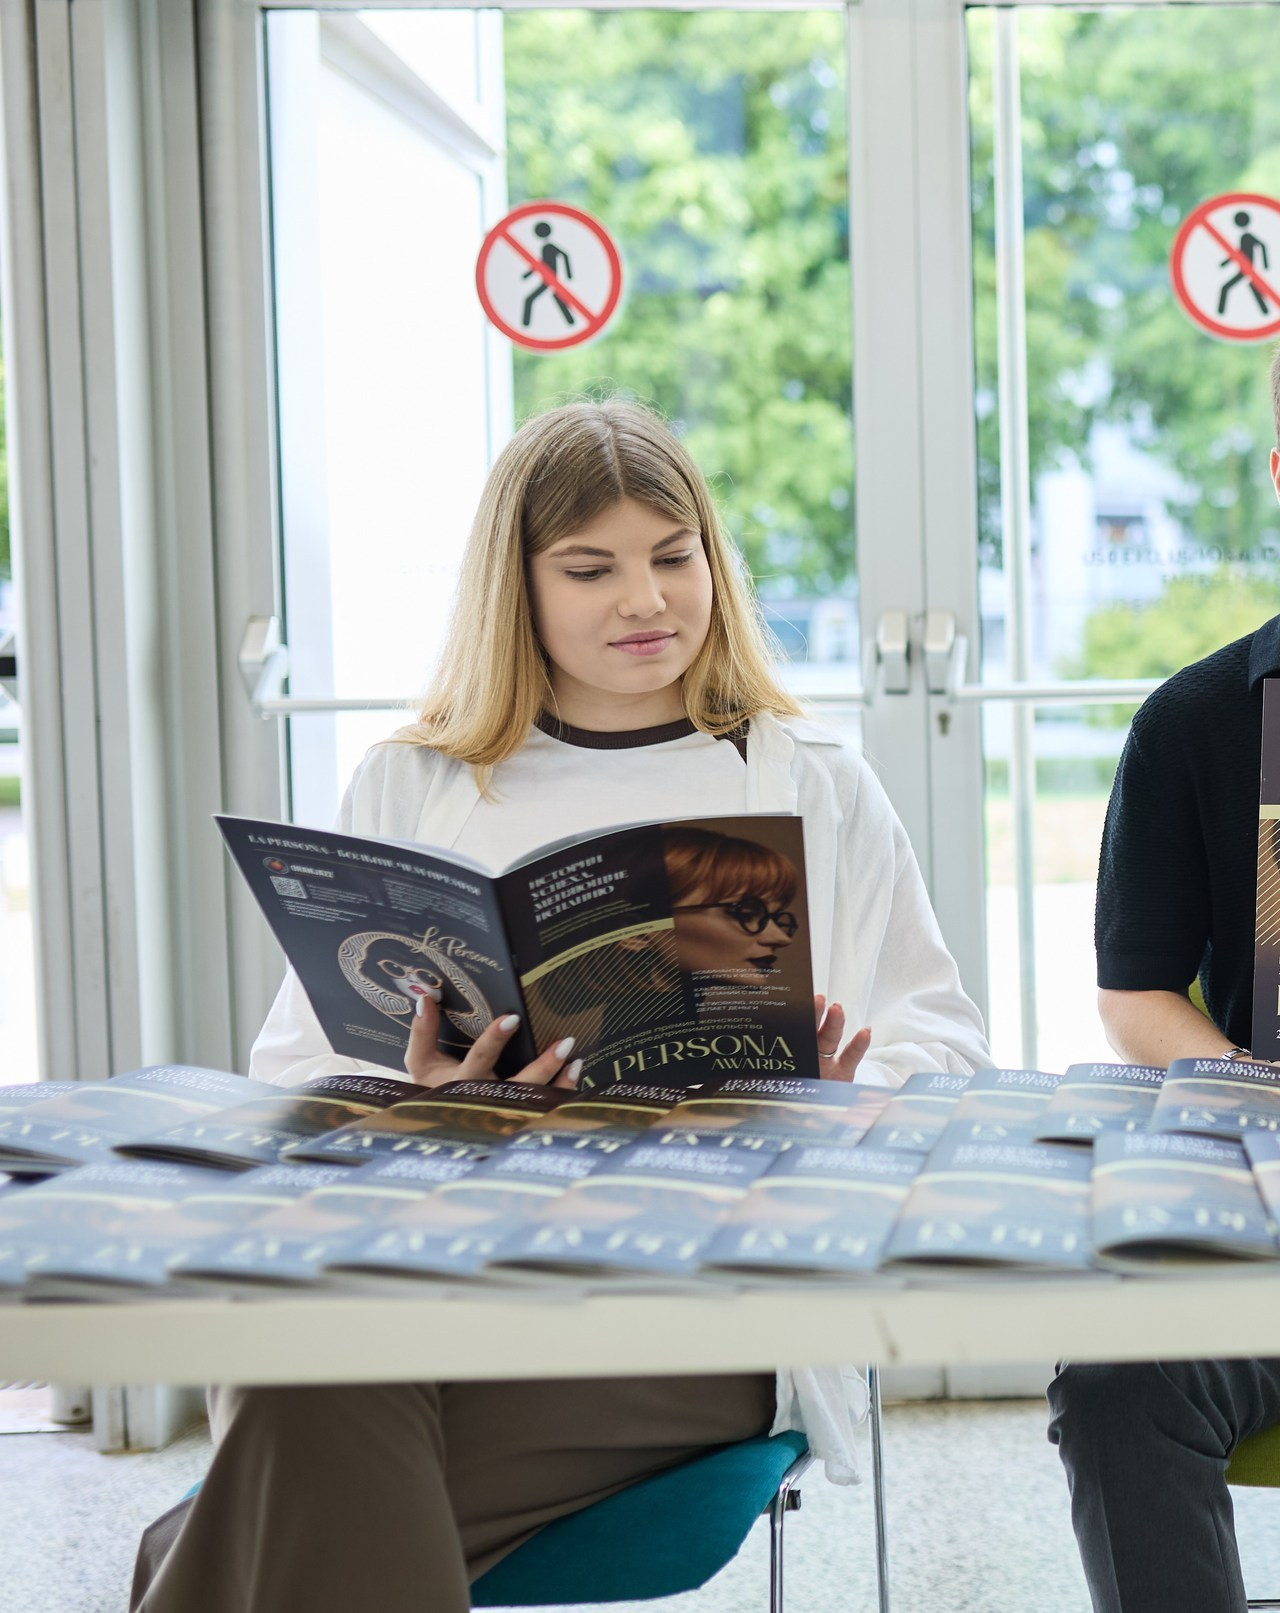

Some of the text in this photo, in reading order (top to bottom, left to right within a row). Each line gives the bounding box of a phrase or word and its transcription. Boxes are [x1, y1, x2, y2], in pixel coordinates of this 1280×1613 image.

[529, 854, 603, 890] ИСТОРИИ
[535, 885, 615, 923] ИСПАНИЮ
[612, 1034, 794, 1082] PERSONA
[711, 1057, 797, 1072] AWARDS
